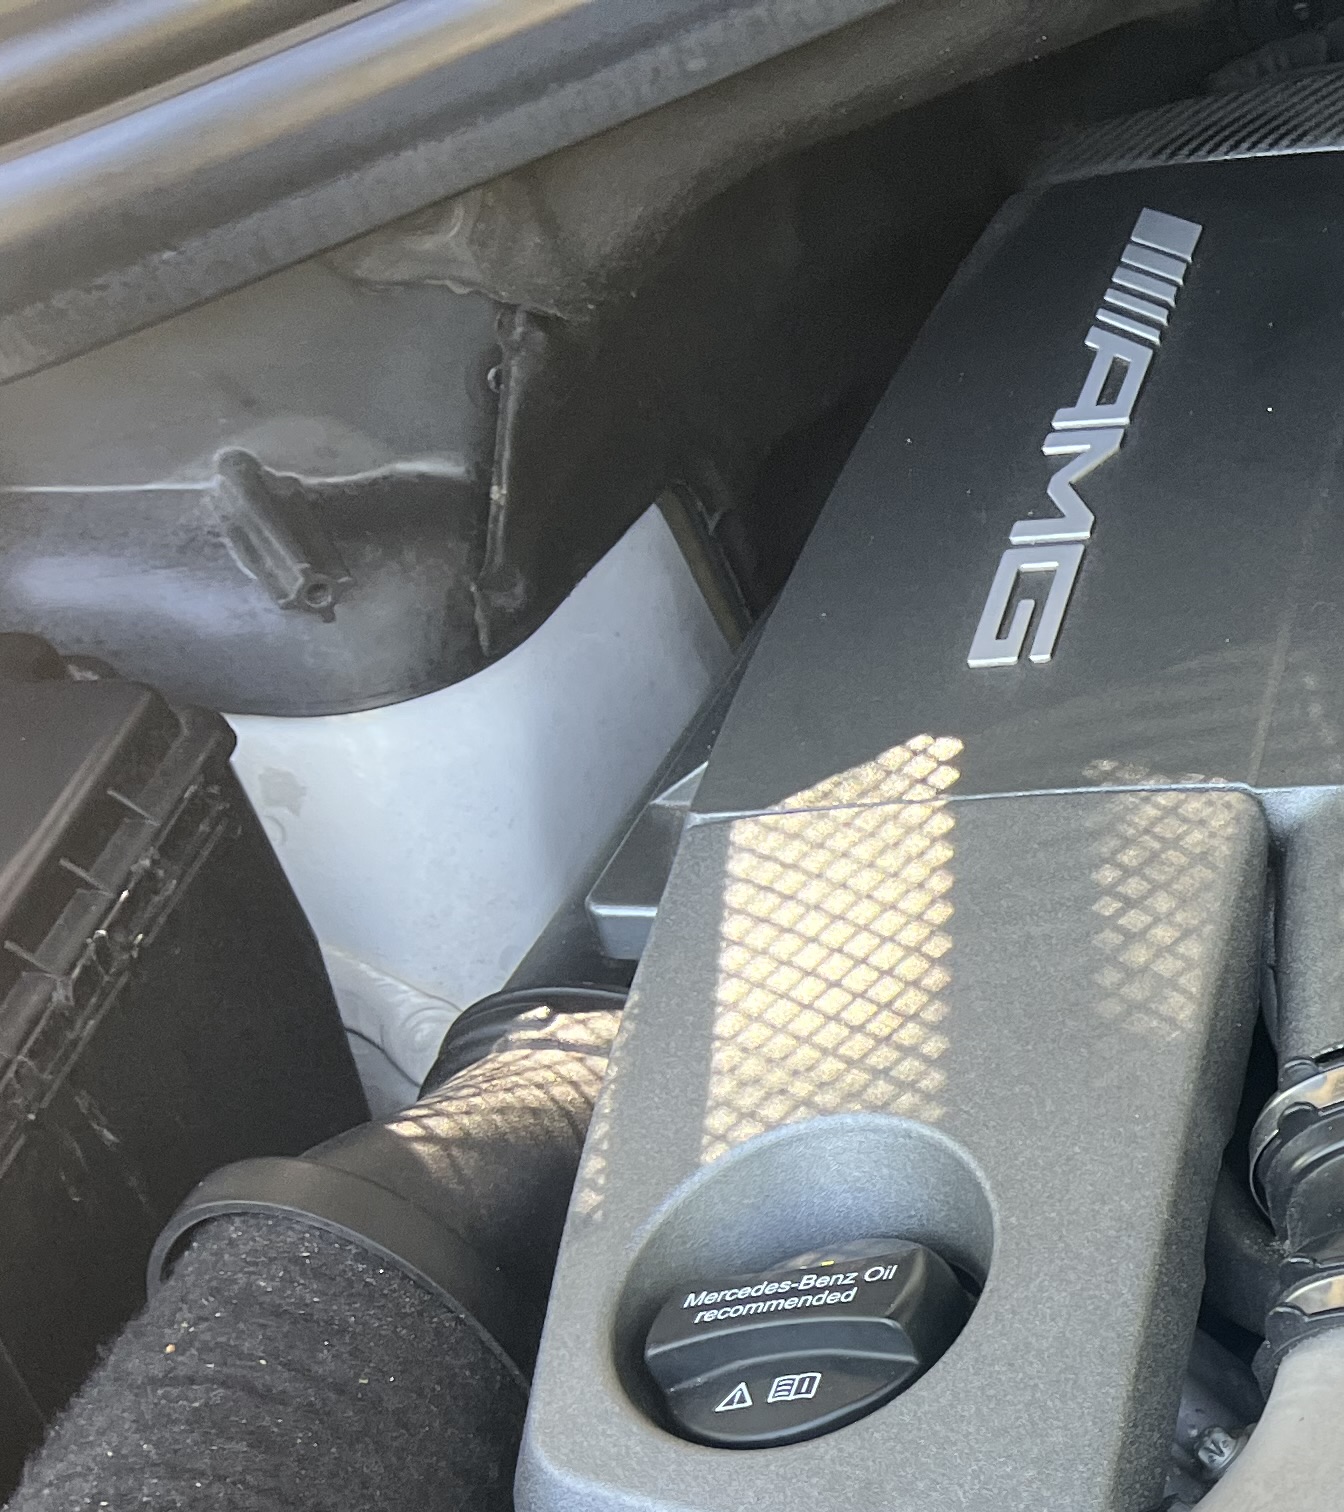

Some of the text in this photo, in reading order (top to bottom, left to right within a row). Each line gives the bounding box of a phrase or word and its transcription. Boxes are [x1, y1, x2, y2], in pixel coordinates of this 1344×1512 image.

[683, 1264, 898, 1308] Mercedes-Benz Oil
[694, 1286, 857, 1324] recommended
